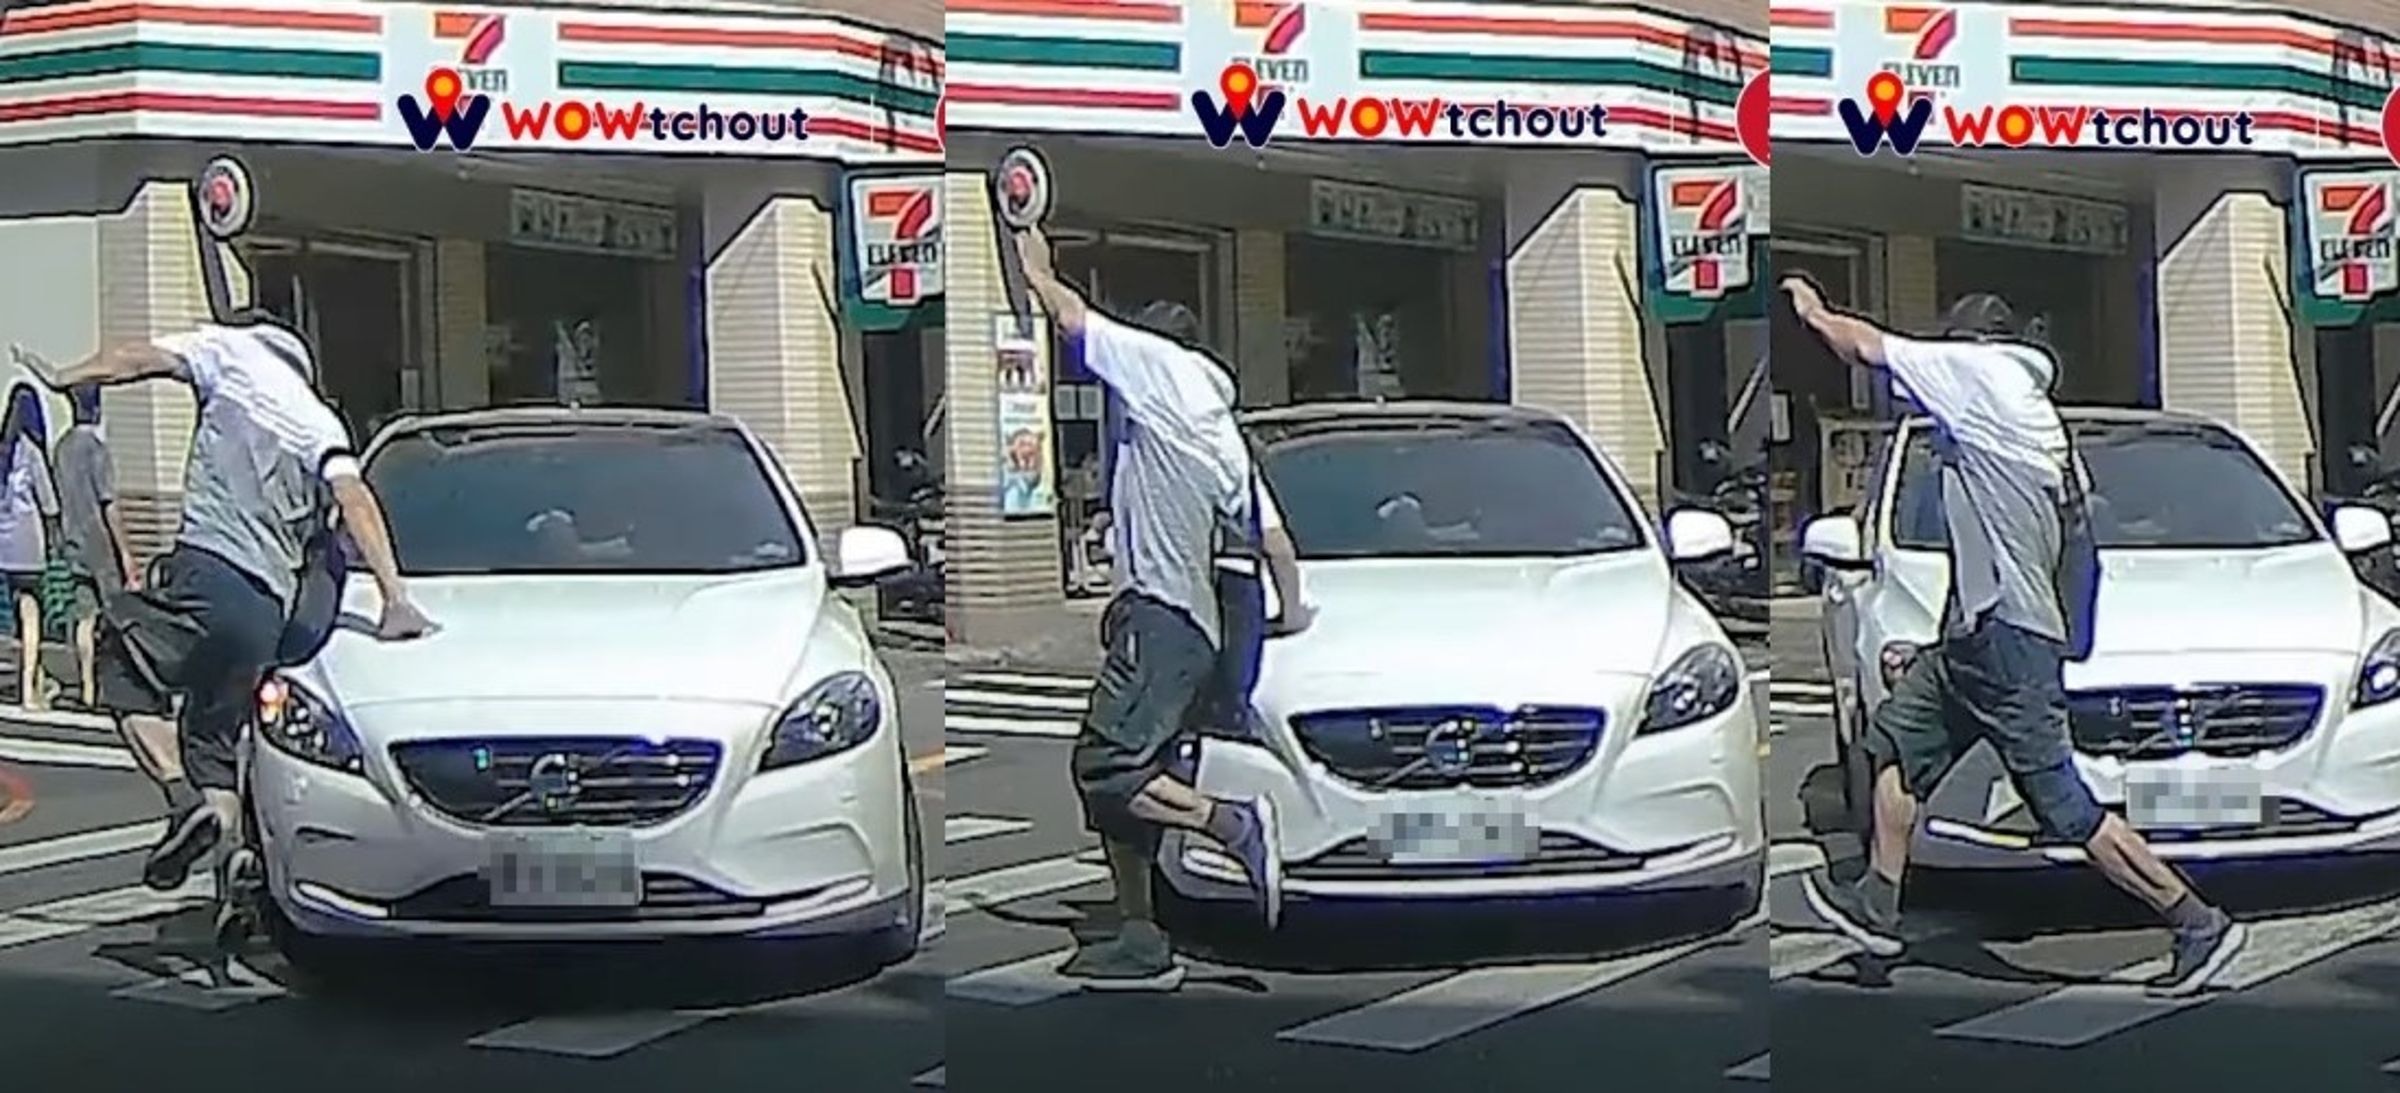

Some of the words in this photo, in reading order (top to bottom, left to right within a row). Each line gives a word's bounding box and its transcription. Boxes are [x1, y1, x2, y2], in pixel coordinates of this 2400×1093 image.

[868, 189, 933, 299] 7
[1672, 179, 1736, 290] 7
[2321, 184, 2386, 295] 7
